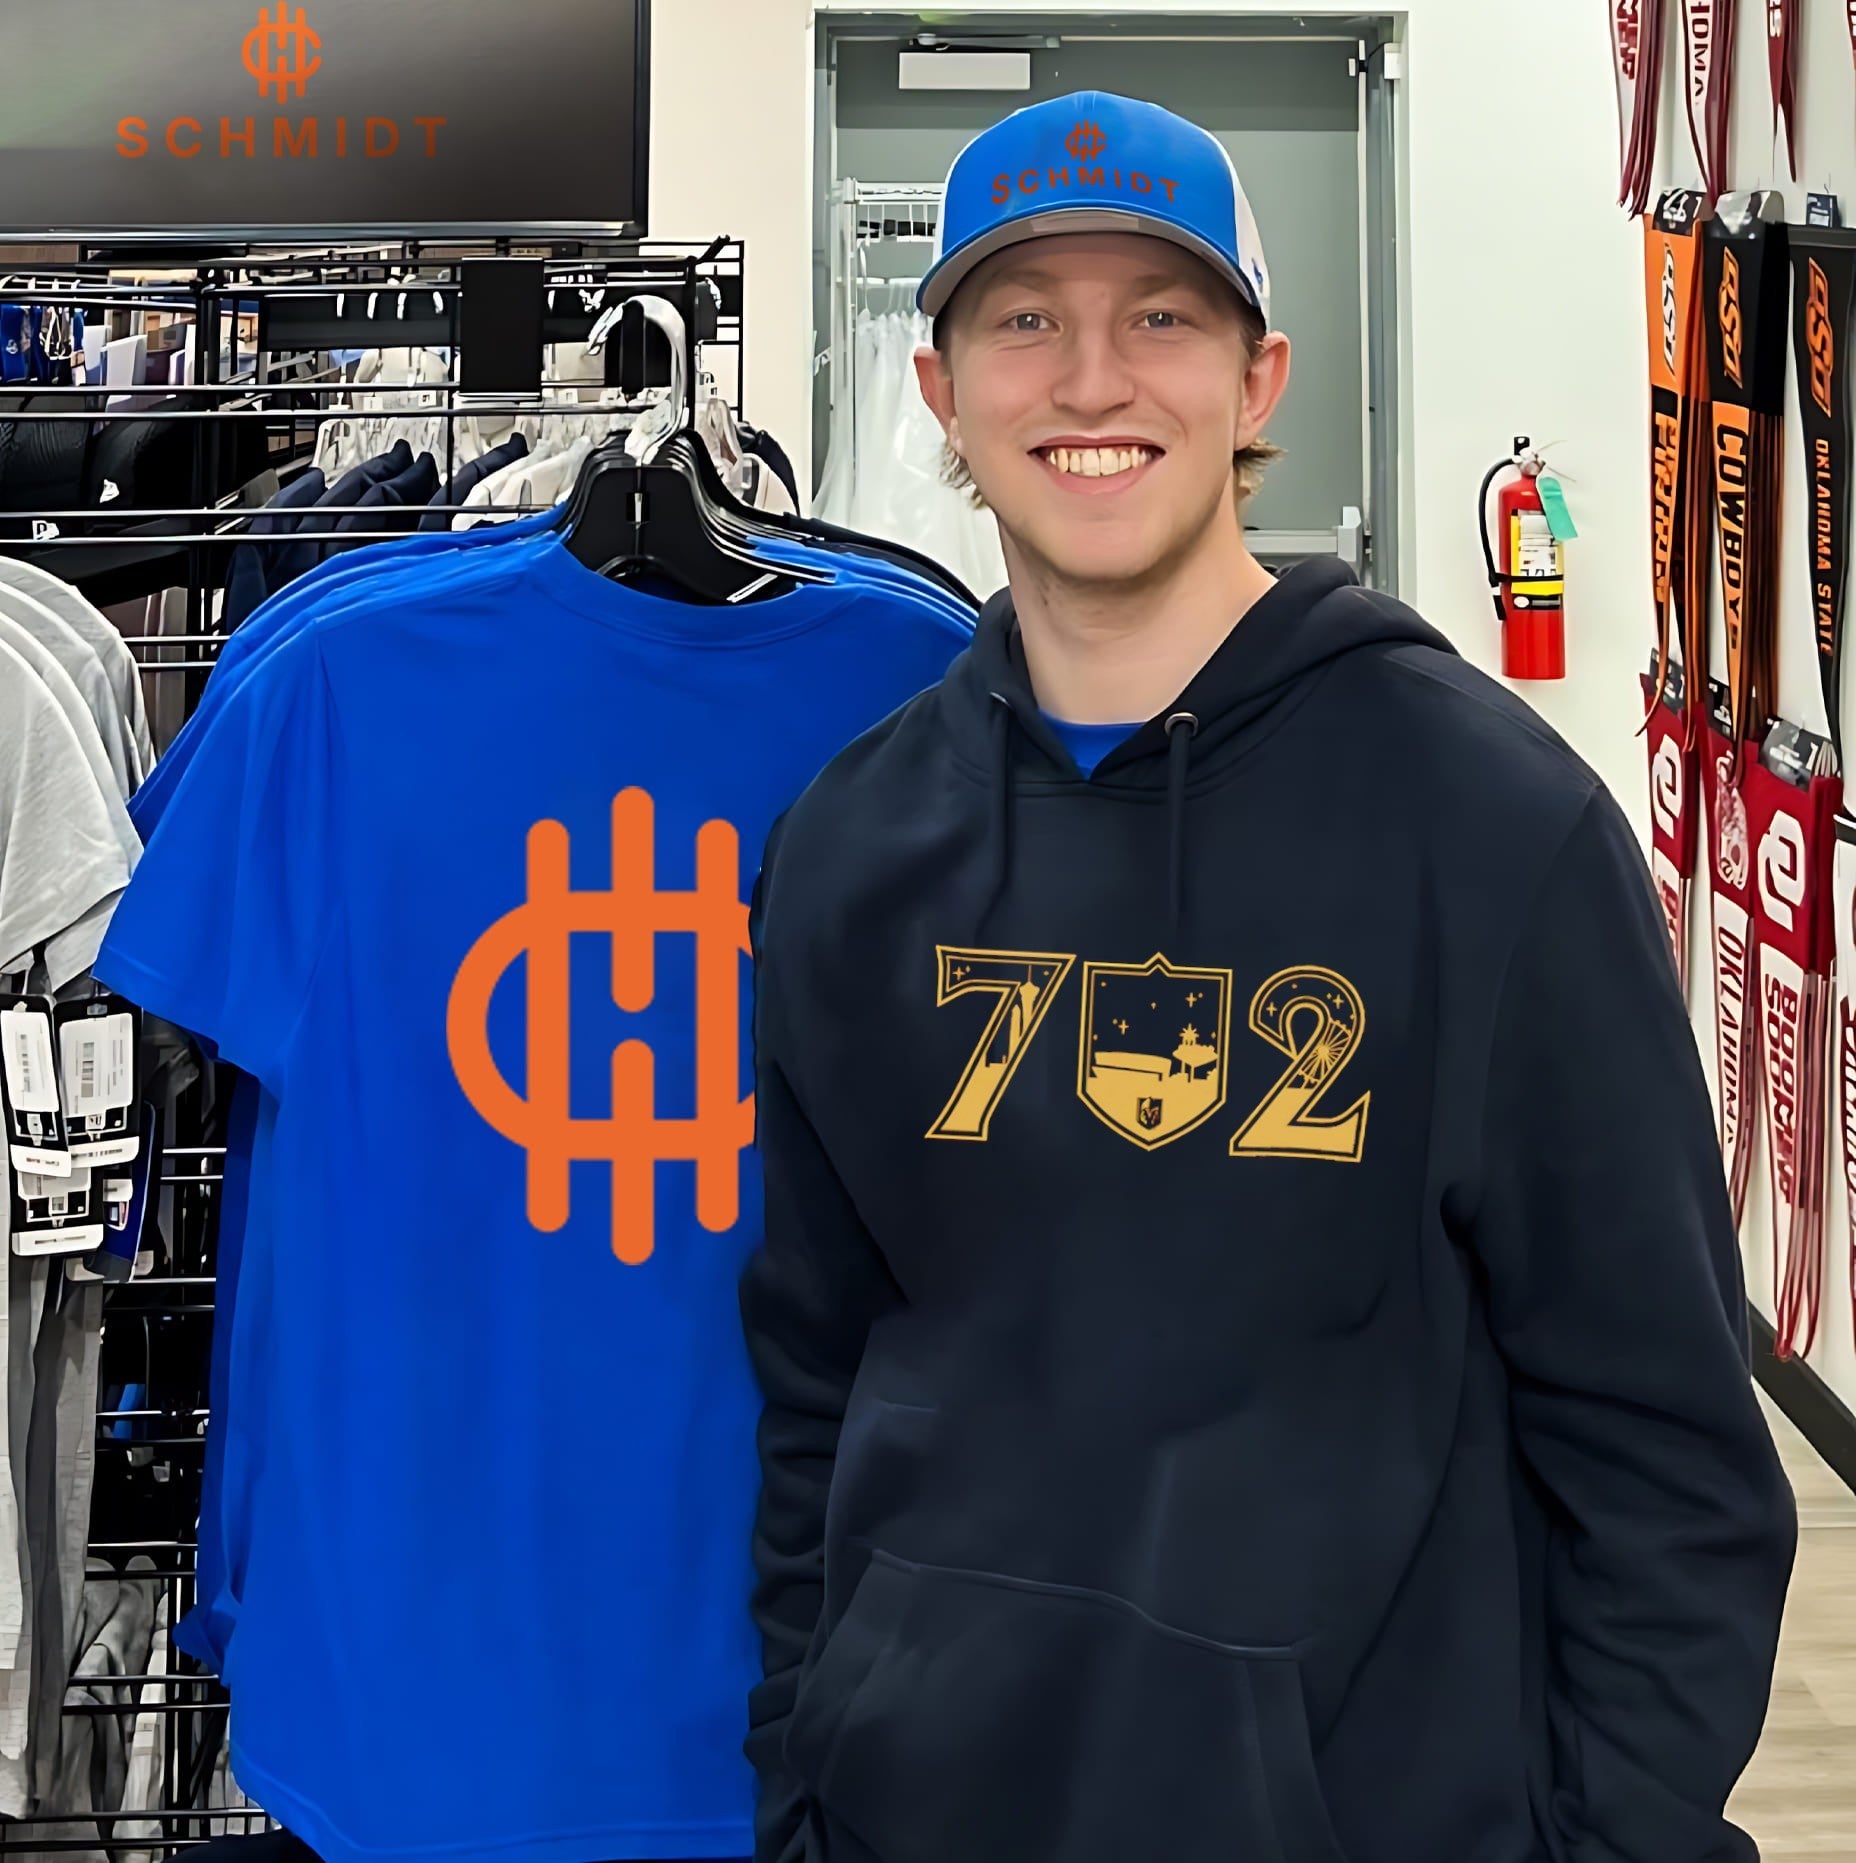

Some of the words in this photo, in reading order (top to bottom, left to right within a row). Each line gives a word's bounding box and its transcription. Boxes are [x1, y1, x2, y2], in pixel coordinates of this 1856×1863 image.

[115, 116, 448, 159] SCHMIDT
[991, 166, 1180, 205] SCHMIDT
[1815, 438, 1833, 570] OKLAHOMA
[1816, 582, 1834, 657] STATE
